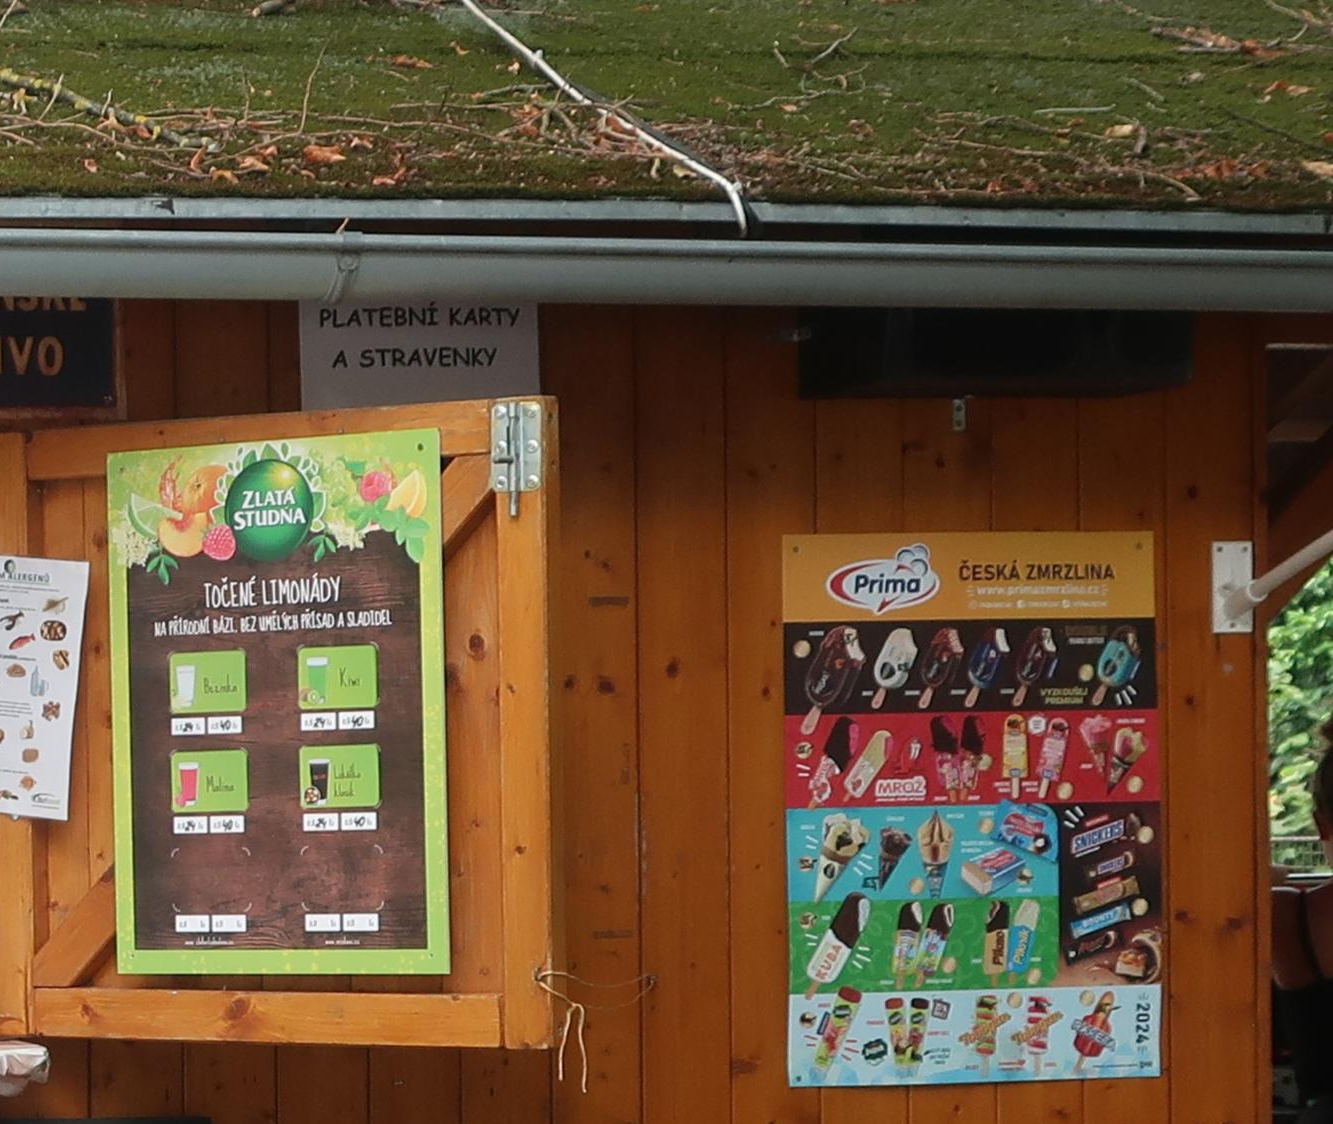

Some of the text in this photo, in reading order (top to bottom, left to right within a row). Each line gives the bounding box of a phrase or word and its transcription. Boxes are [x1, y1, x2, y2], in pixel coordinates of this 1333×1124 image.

[319, 301, 520, 329] PLATEBNÍ KARTY
[333, 346, 497, 369] A STRAVENKY
[241, 489, 296, 509] ZLATÁ
[959, 559, 1115, 582] ČESKÁ ZMRZLINA
[204, 576, 341, 608] TOČENÉ LIMONÁDY
[855, 571, 921, 597] Prima
[154, 623, 167, 637] NA
[241, 616, 257, 632] BEZ
[338, 612, 344, 627] A
[347, 610, 392, 626] SLADIDEL
